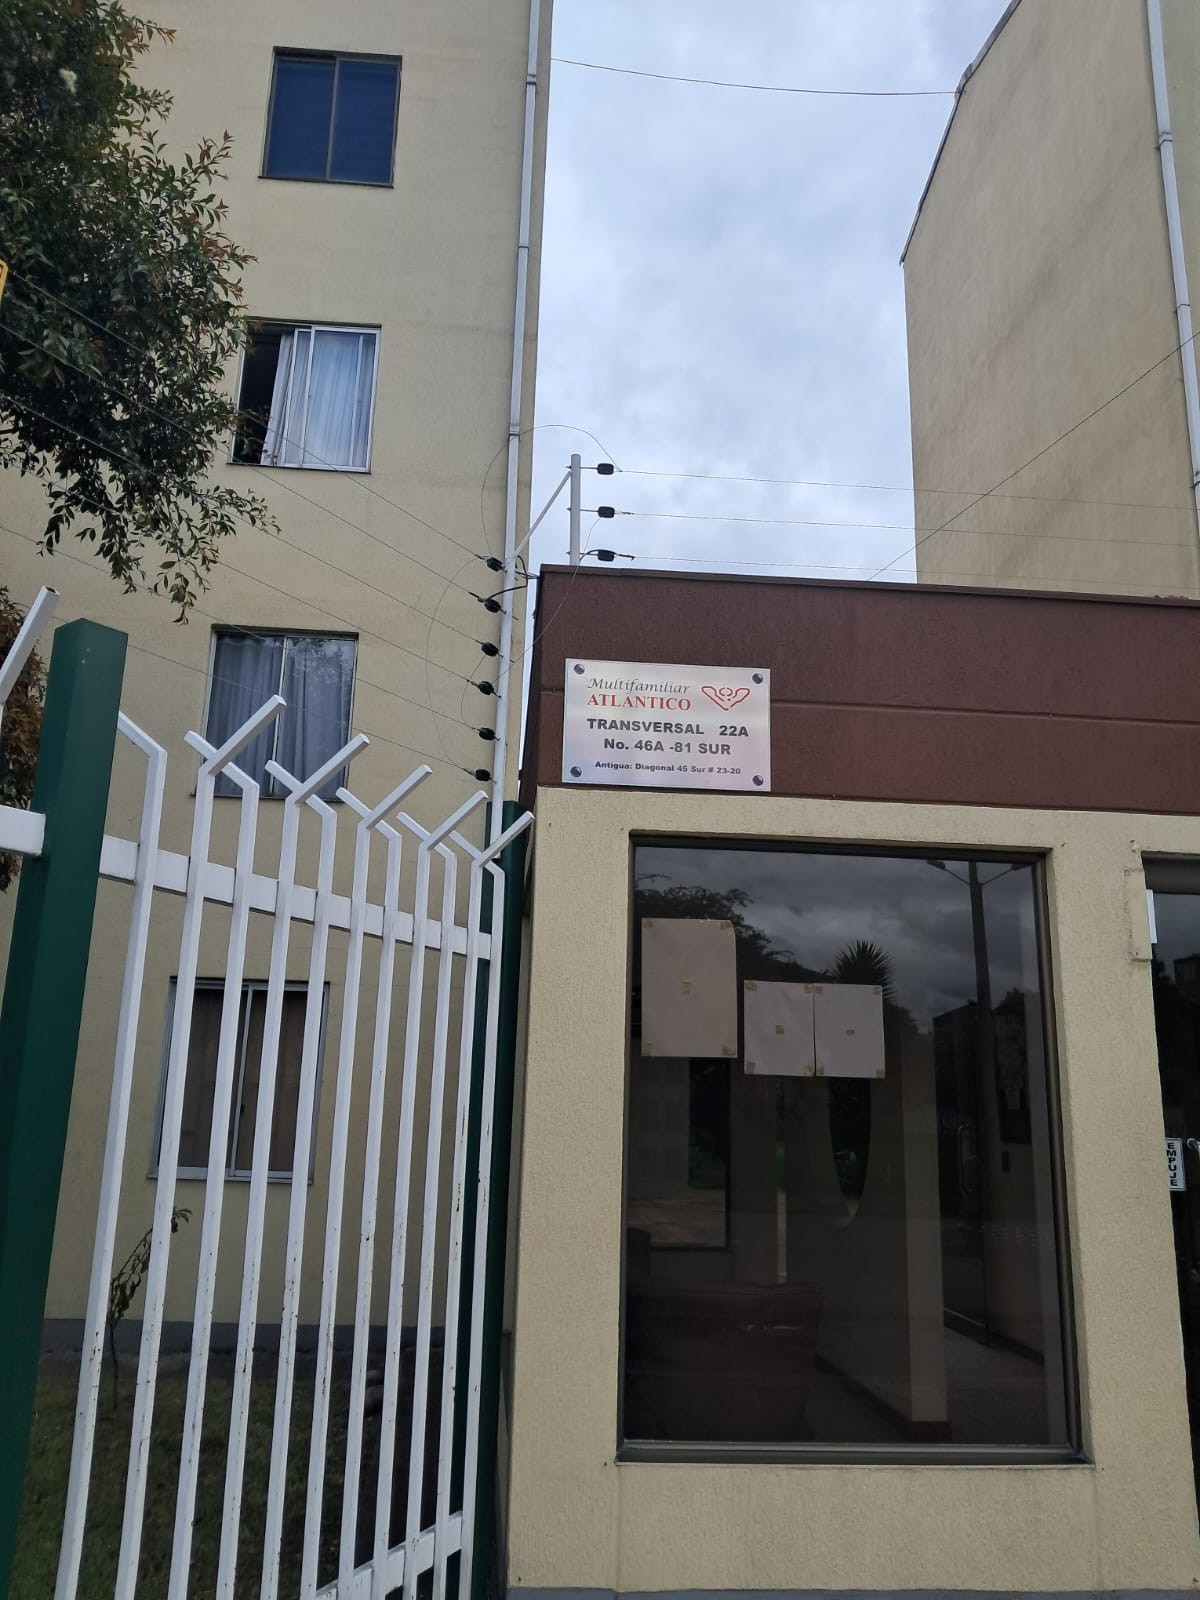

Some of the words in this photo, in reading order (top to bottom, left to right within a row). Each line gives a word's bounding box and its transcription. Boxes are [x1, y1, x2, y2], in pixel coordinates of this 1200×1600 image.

[586, 677, 691, 694] Multifamiliar
[587, 718, 704, 735] TRANSVERSAL
[719, 725, 749, 737] 22A
[603, 738, 629, 750] No.
[634, 739, 664, 752] 46A
[698, 743, 731, 755] SUR
[595, 761, 633, 771] Antigua:
[635, 763, 675, 773] Diagonal
[677, 764, 688, 772] 45
[690, 765, 706, 773] Sur
[708, 766, 714, 774] #
[716, 767, 741, 775] 23-20
[1166, 1142, 1178, 1187] EMPUJE
